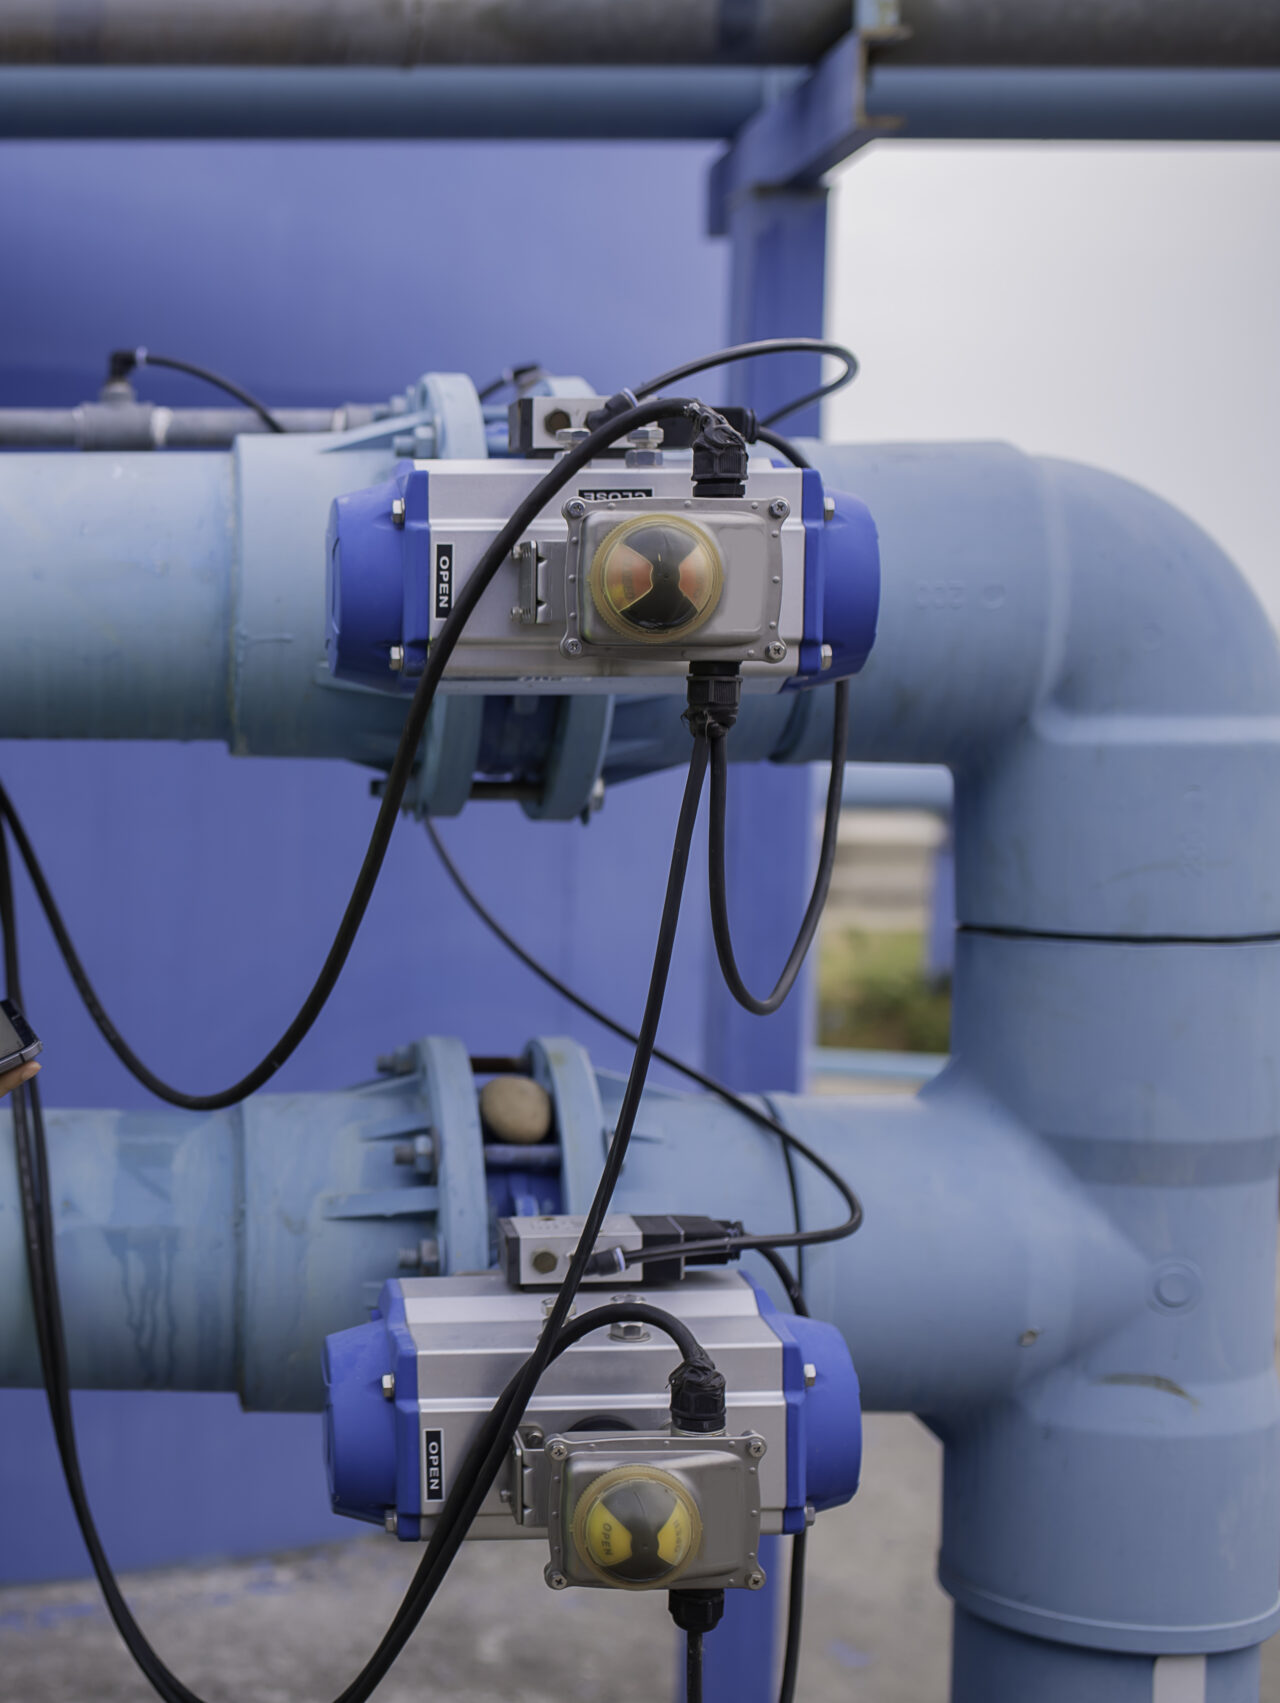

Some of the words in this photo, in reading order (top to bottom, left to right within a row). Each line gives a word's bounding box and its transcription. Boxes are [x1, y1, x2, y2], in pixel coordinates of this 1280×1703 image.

[438, 556, 450, 608] OPEN
[428, 1441, 440, 1490] OPEN
[602, 1522, 614, 1556] OPEN
